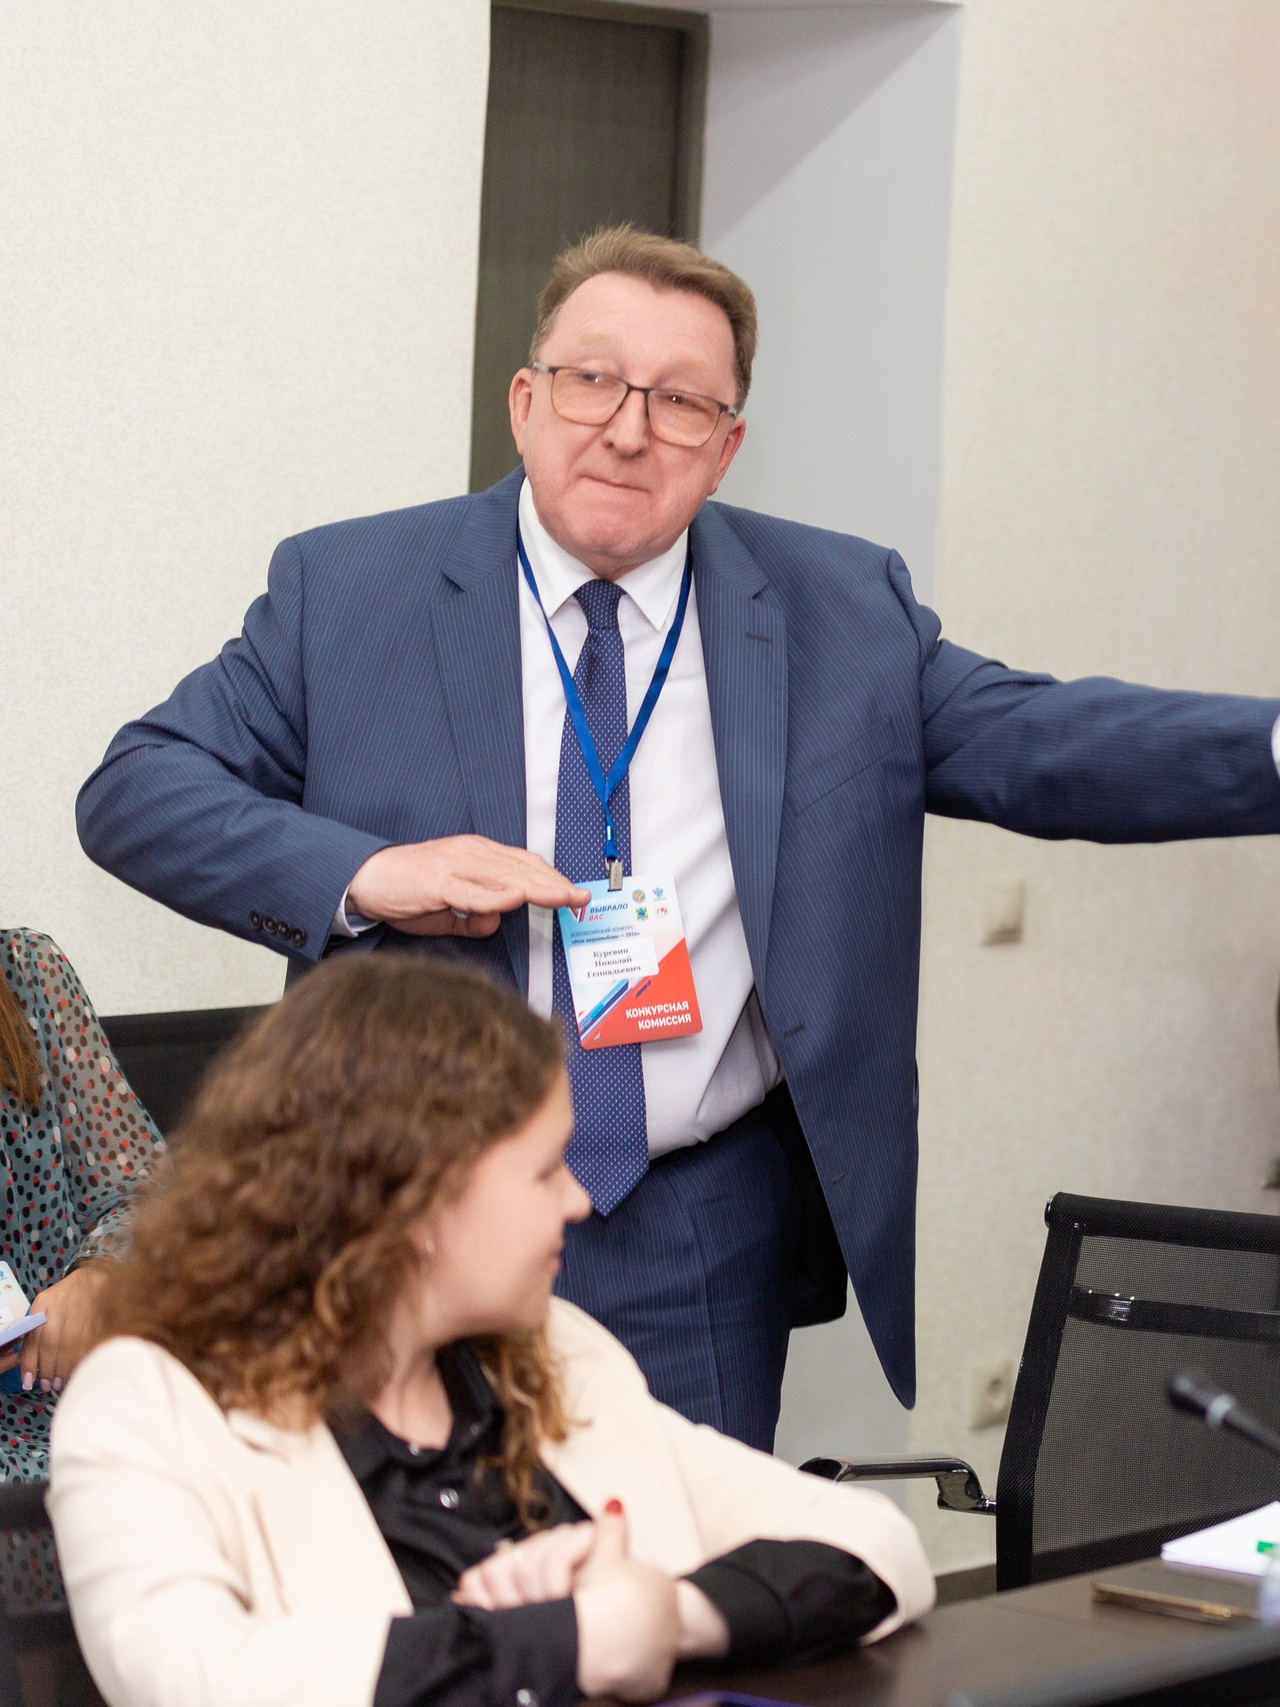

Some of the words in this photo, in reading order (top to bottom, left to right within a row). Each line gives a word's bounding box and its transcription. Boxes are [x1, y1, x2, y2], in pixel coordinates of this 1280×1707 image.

[590, 903, 629, 914] ВЫБРАЛО
[588, 913, 604, 922] ВАС
[594, 955, 632, 968] Николай
[587, 965, 641, 978] Геннадьевич
[625, 1000, 690, 1020] КОНКУРСНАЯ
[637, 1013, 692, 1031] КОМИССИЯ
